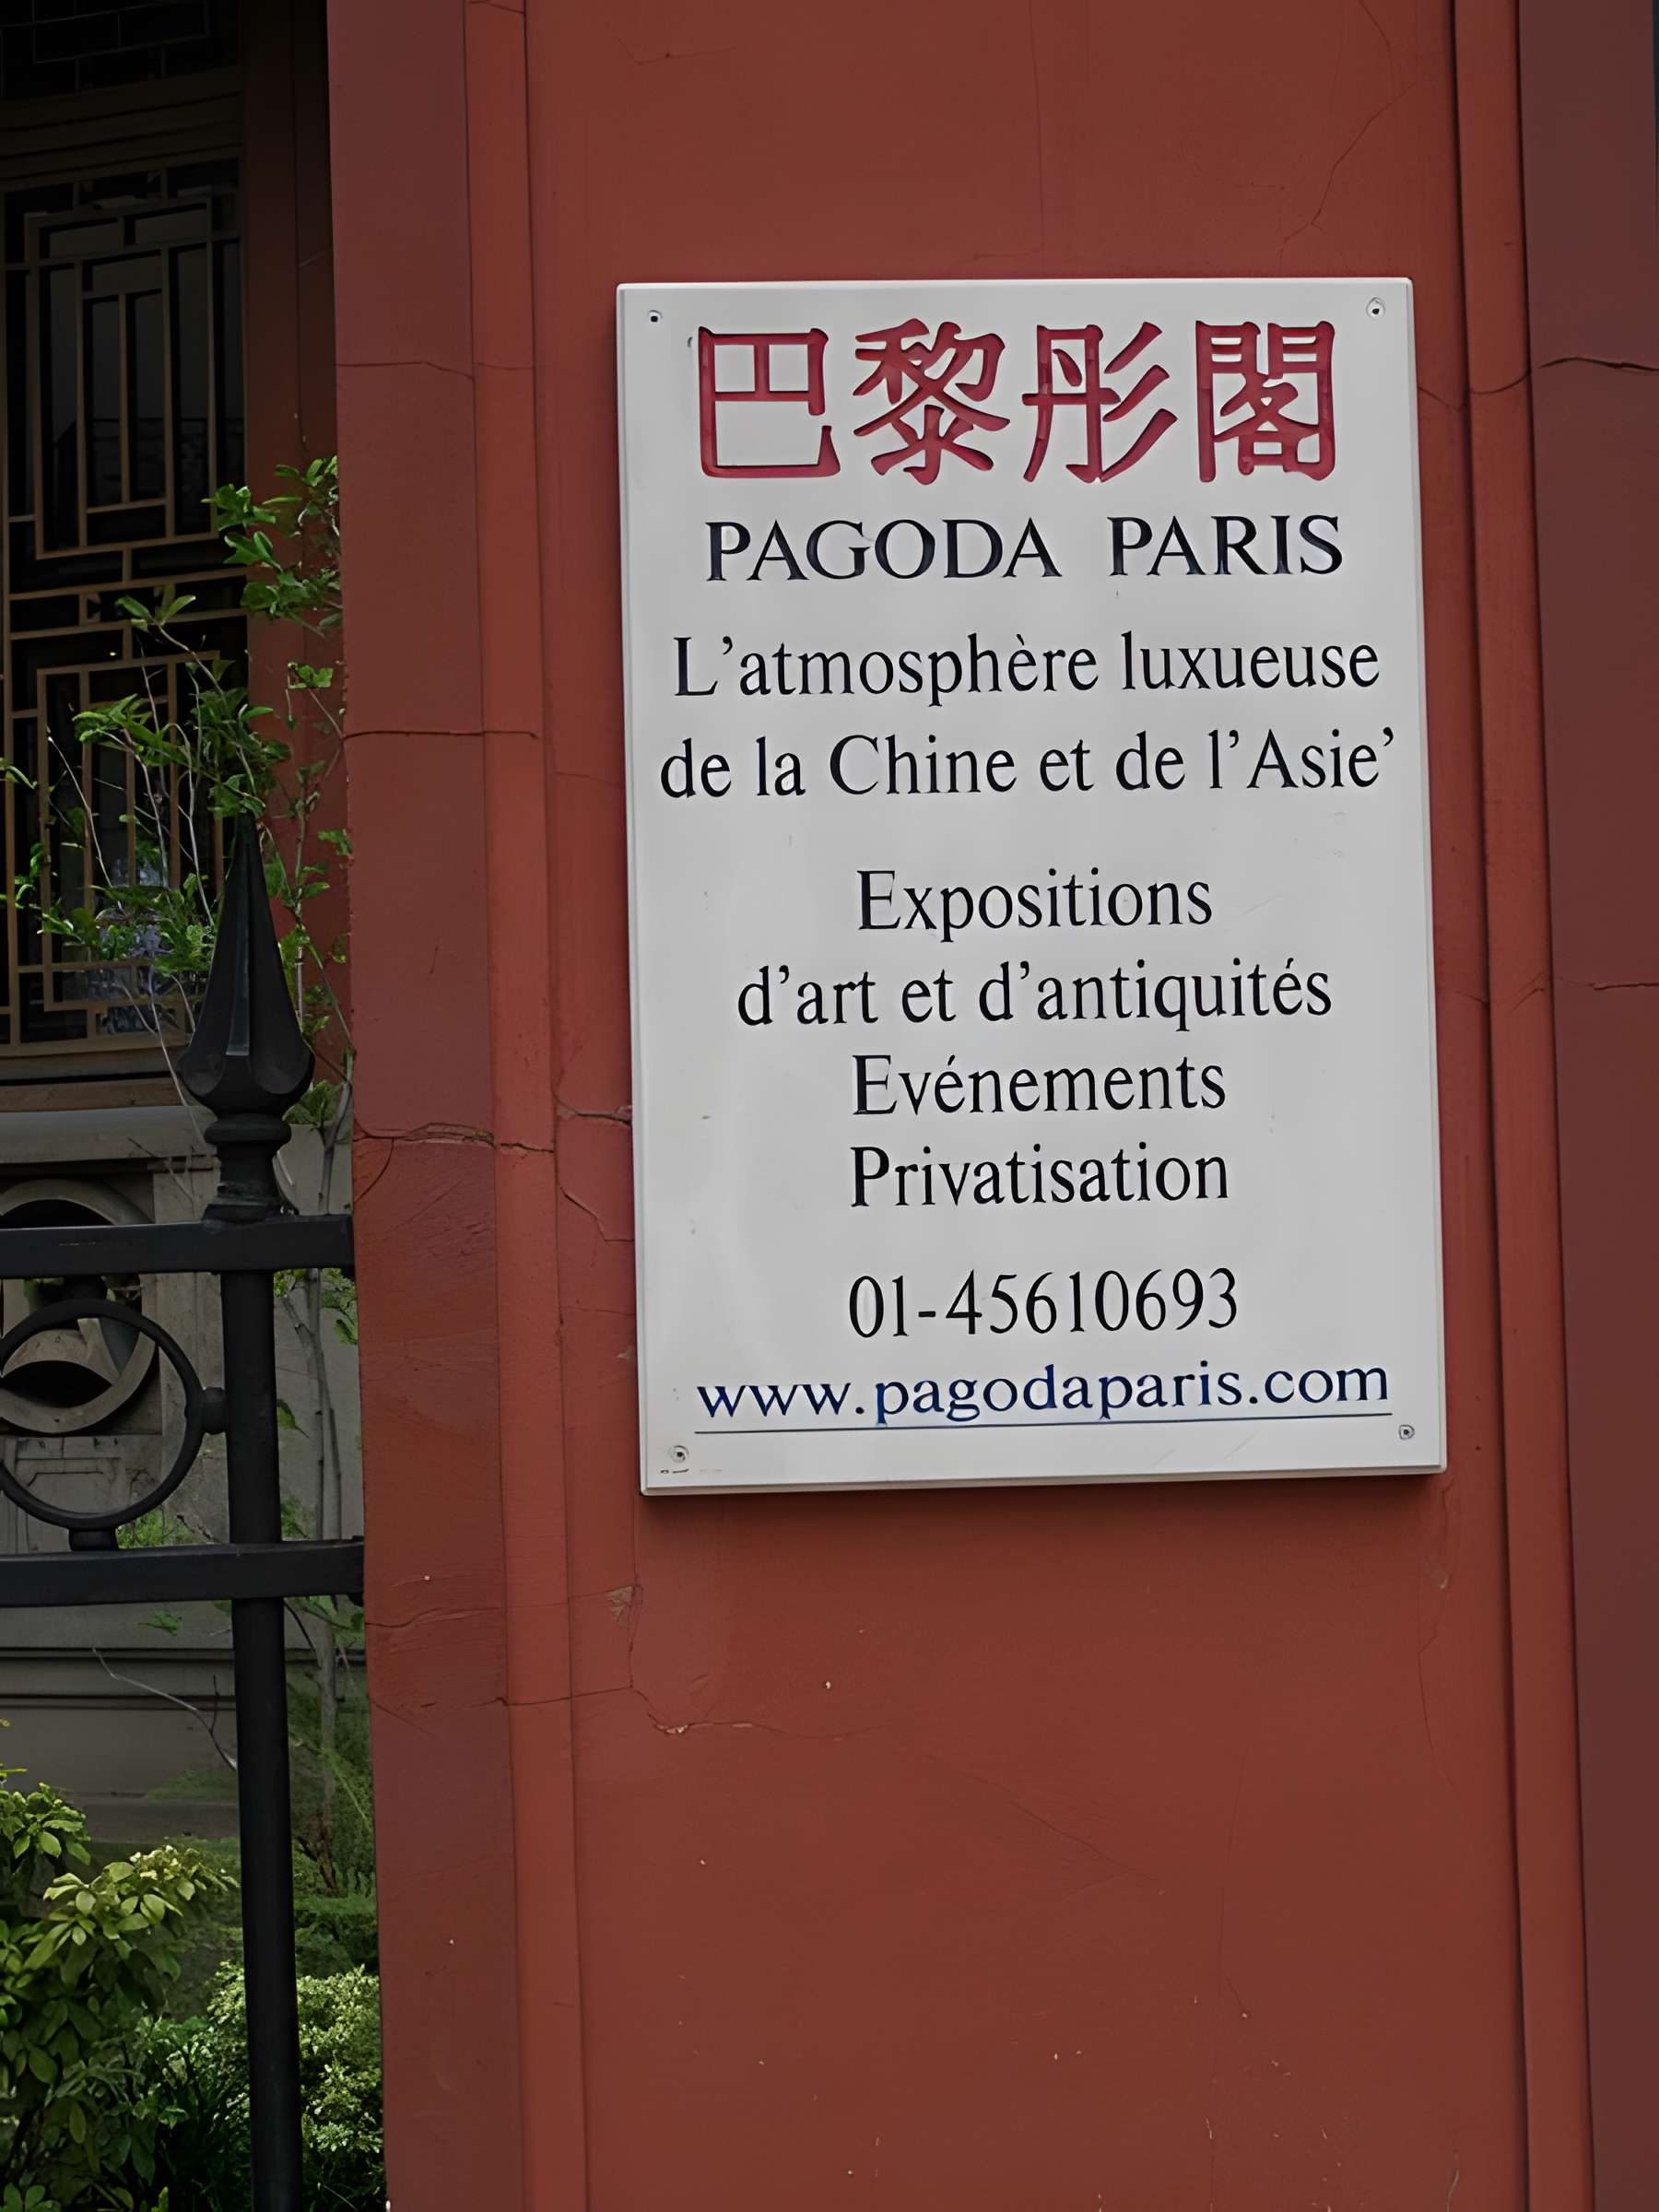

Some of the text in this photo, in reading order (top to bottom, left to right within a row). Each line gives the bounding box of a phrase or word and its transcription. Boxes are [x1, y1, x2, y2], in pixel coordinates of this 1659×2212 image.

[698, 317, 1336, 486] 巴黎彤閣
[704, 514, 1343, 582] PAGODA PARIS
[673, 629, 1380, 708] L’atmosphère luxueuse
[660, 737, 732, 799] de
[755, 735, 806, 796] la
[830, 734, 1018, 795] Chine
[1040, 741, 1095, 792] et
[1115, 730, 1185, 791] de
[856, 866, 1213, 944] Expositions
[737, 957, 1332, 1032] d’art et d’antiquités
[852, 1054, 1226, 1116] Evénements
[850, 1141, 1229, 1207] Privatisation
[849, 1267, 1237, 1338] 01-45610693
[696, 1359, 1388, 1424] www.pagodaparis.com
